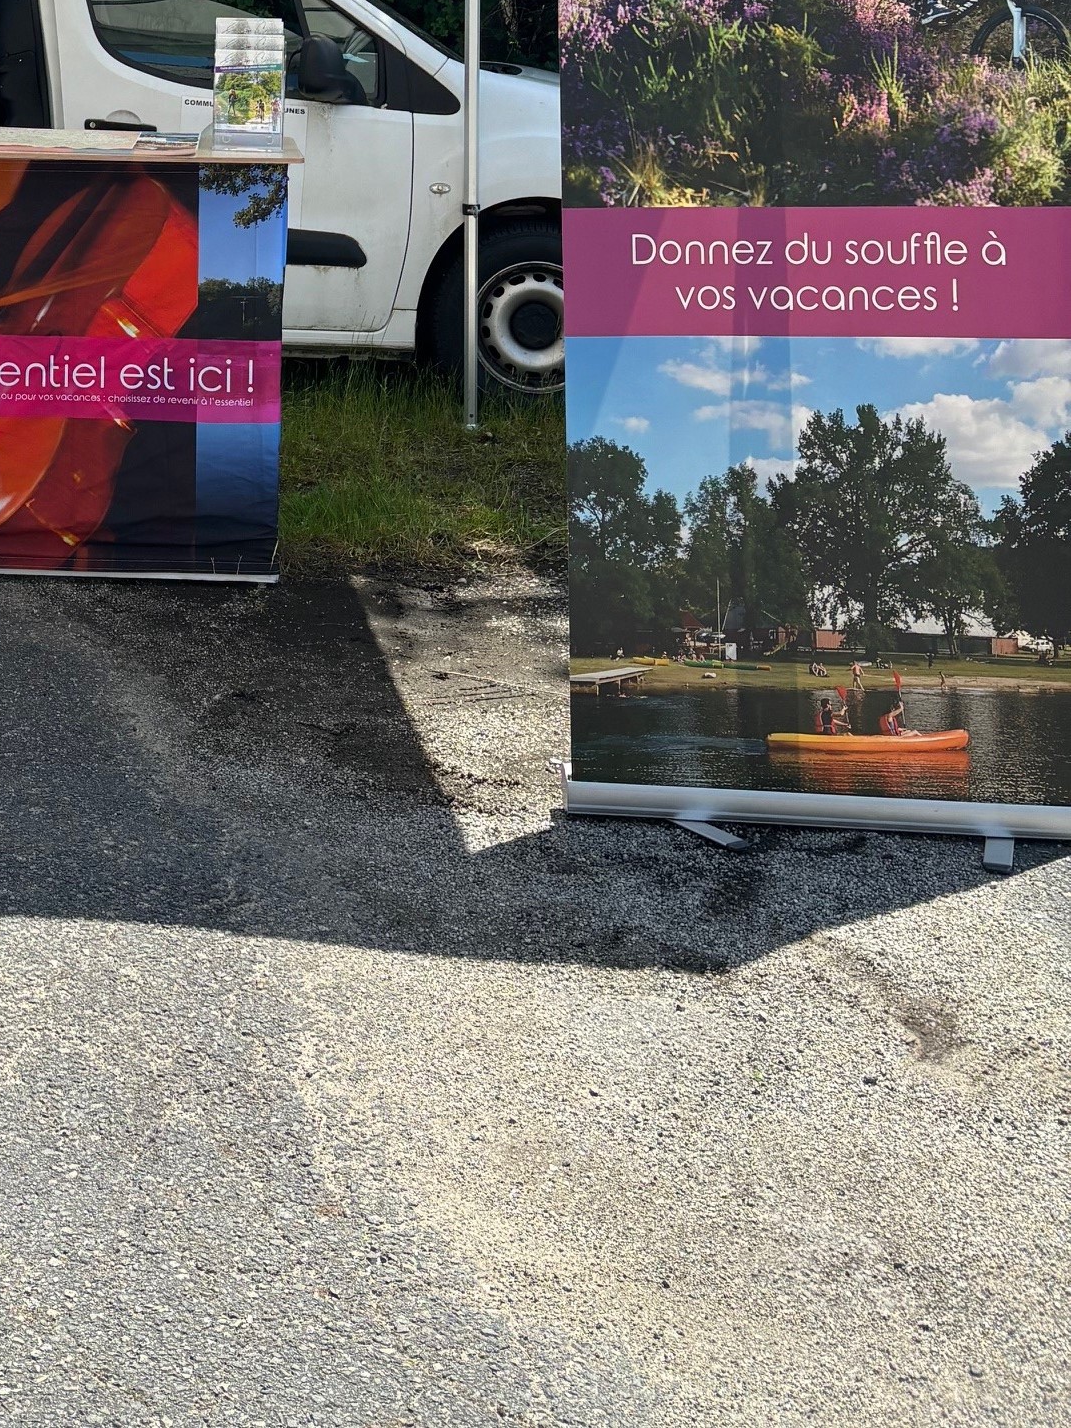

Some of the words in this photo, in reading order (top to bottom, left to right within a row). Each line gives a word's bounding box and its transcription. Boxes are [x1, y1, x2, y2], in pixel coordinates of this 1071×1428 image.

[631, 233, 774, 266] Donnez
[785, 232, 831, 266] du
[844, 231, 968, 266] souffle
[981, 230, 1007, 266] à
[675, 284, 736, 311] vos
[747, 284, 937, 311] vacances
[951, 278, 959, 312] !
[119, 357, 176, 391] est
[189, 357, 232, 393] ici
[247, 359, 254, 393] !
[1, 393, 13, 401] ou
[15, 393, 37, 403] pour
[55, 394, 101, 403] vacances
[107, 394, 151, 403] choisissez
[153, 395, 166, 404] de
[167, 396, 199, 405] revenir
[201, 396, 208, 406] à
[209, 397, 254, 406] l'essentiel
